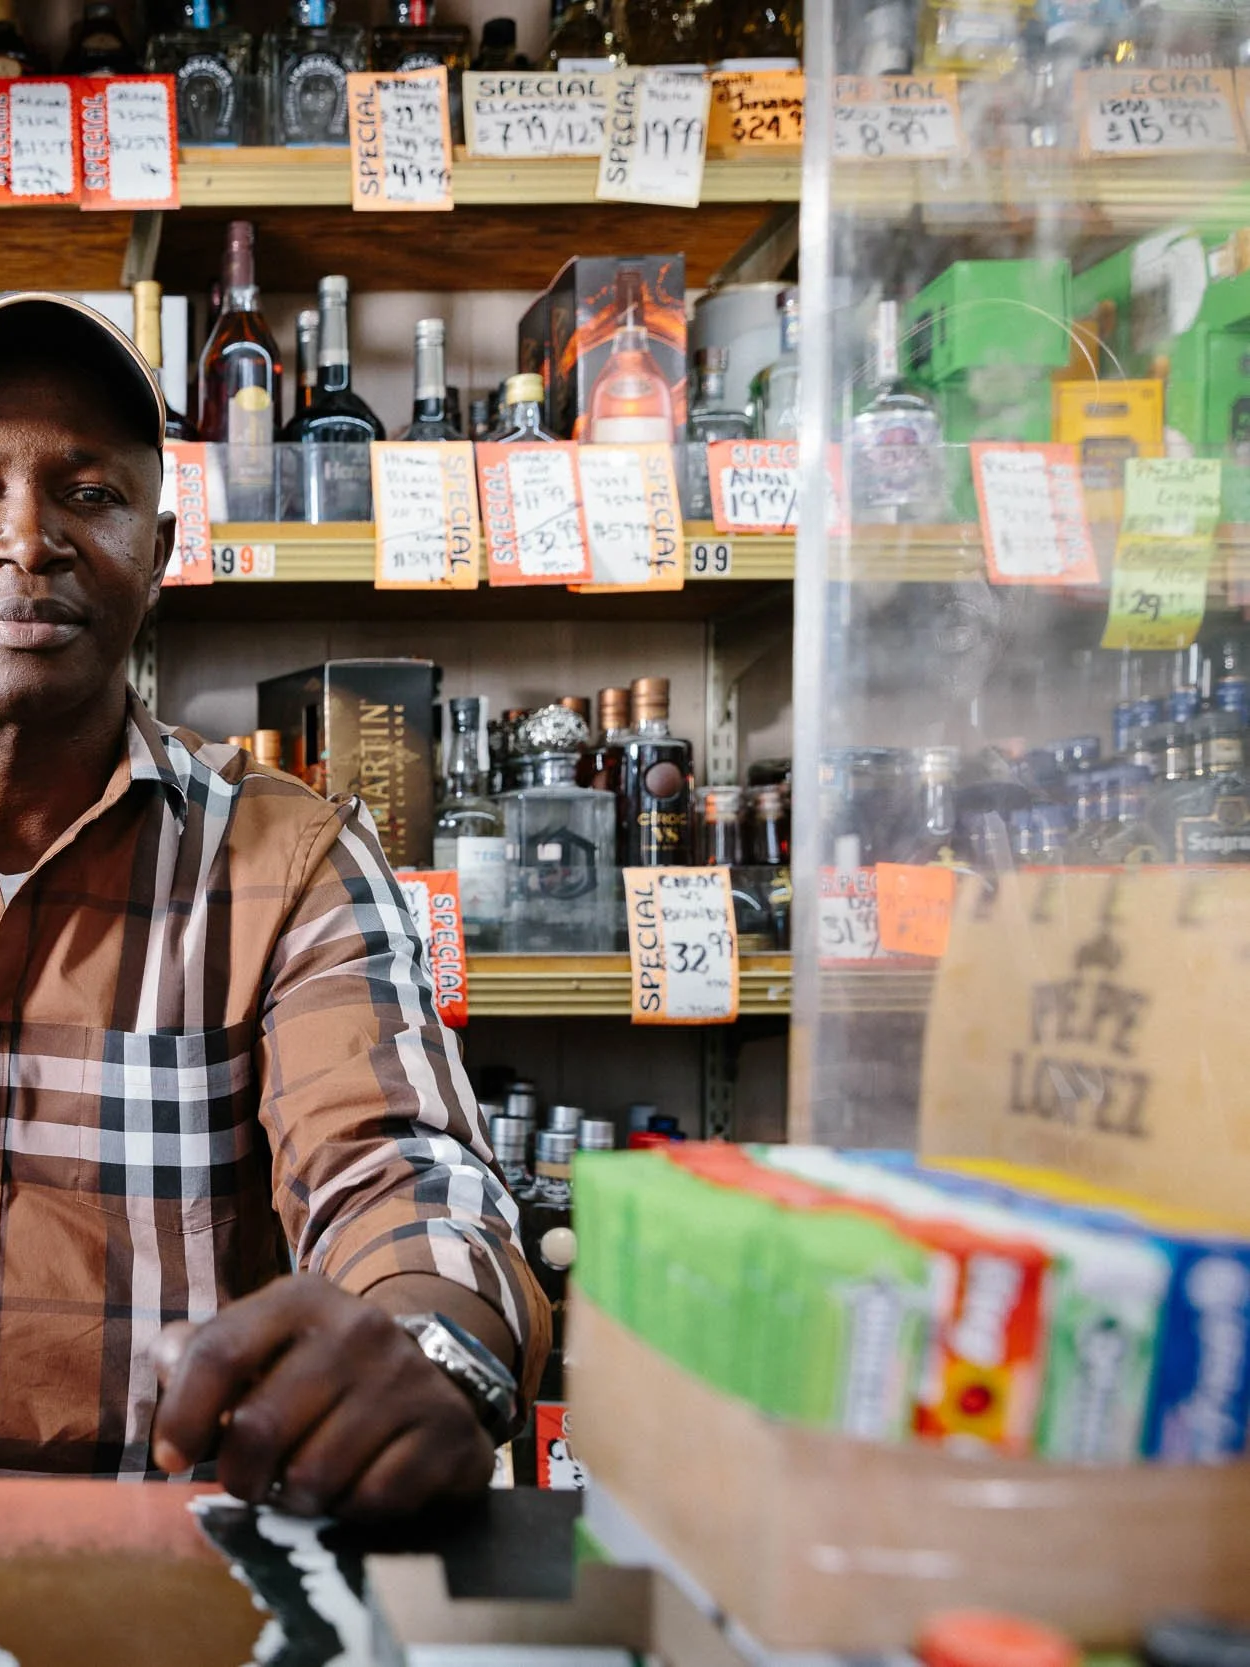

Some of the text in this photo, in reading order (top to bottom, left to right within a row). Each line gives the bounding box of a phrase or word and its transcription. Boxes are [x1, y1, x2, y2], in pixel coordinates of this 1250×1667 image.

[479, 80, 603, 97] SPECIAL
[607, 79, 637, 184] SPECIAL
[82, 93, 108, 190] SPECIAL
[356, 85, 380, 196] SPECIAL
[732, 444, 798, 465] SPEC
[182, 463, 207, 564] SPECIAL
[446, 455, 472, 575] SPECIAL
[484, 463, 514, 563] SPECIAL
[646, 456, 676, 576] SPECIAL
[694, 545, 728, 572] 99
[433, 896, 461, 1007] SPECIAL
[635, 881, 660, 1012] SPECIAL
[1029, 975, 1151, 1057] PEPE
[1010, 1051, 1152, 1138] LOPEZ
